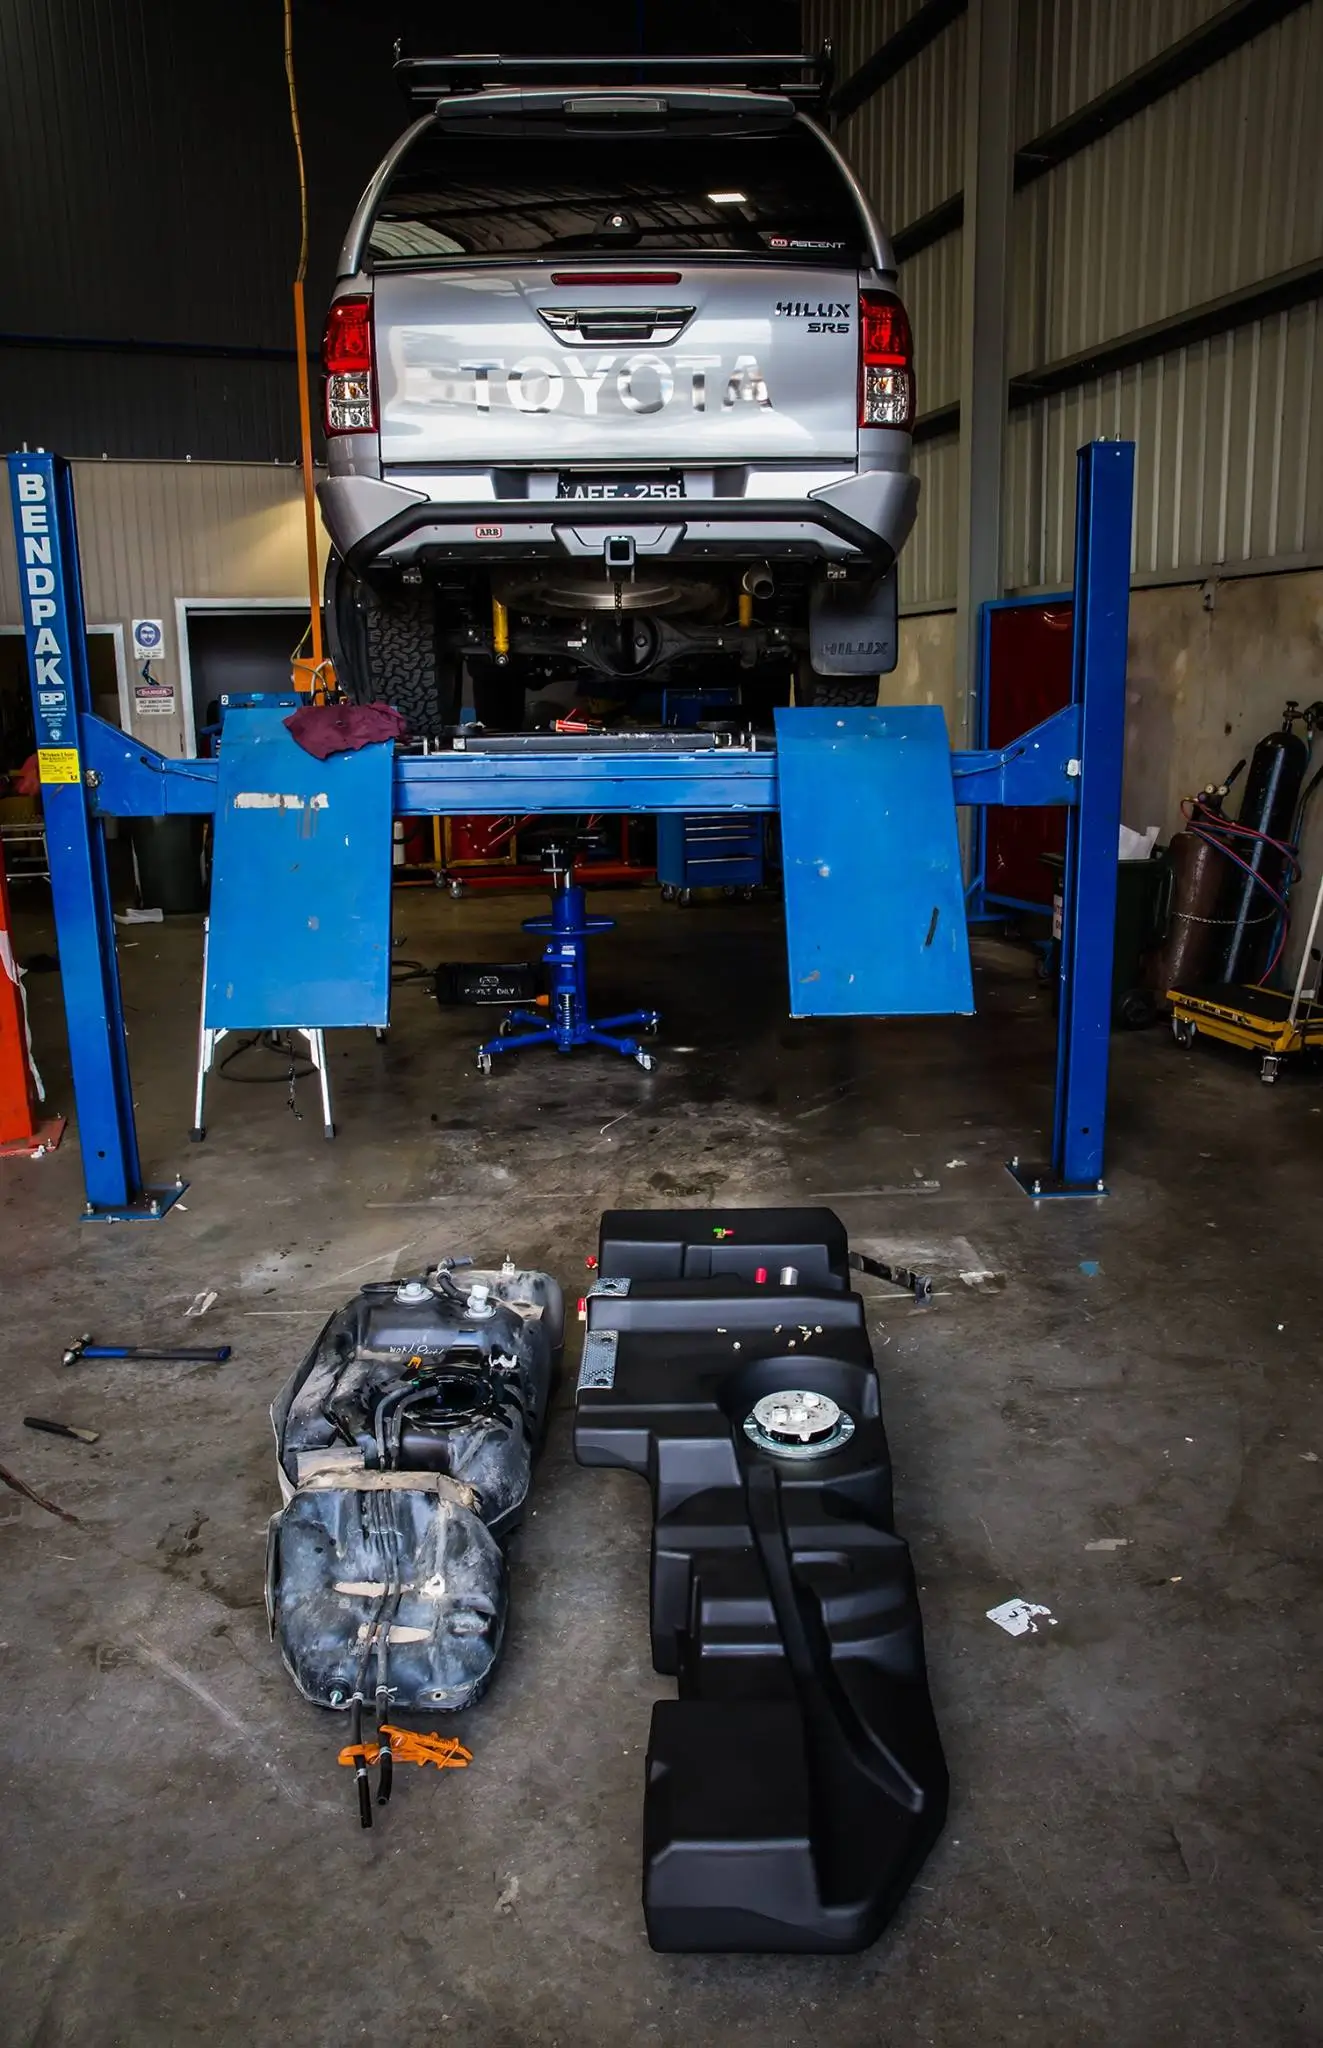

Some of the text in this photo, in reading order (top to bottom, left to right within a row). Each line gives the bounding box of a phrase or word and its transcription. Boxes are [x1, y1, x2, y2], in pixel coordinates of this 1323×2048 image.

[790, 240, 846, 249] ASCENT
[775, 302, 851, 317] HILUX
[807, 322, 850, 334] SR5
[458, 354, 774, 416] TOYOTA
[479, 528, 499, 536] ARB
[17, 474, 64, 685] BENDPAK
[820, 641, 889, 656] HILUX
[39, 692, 64, 705] BP
